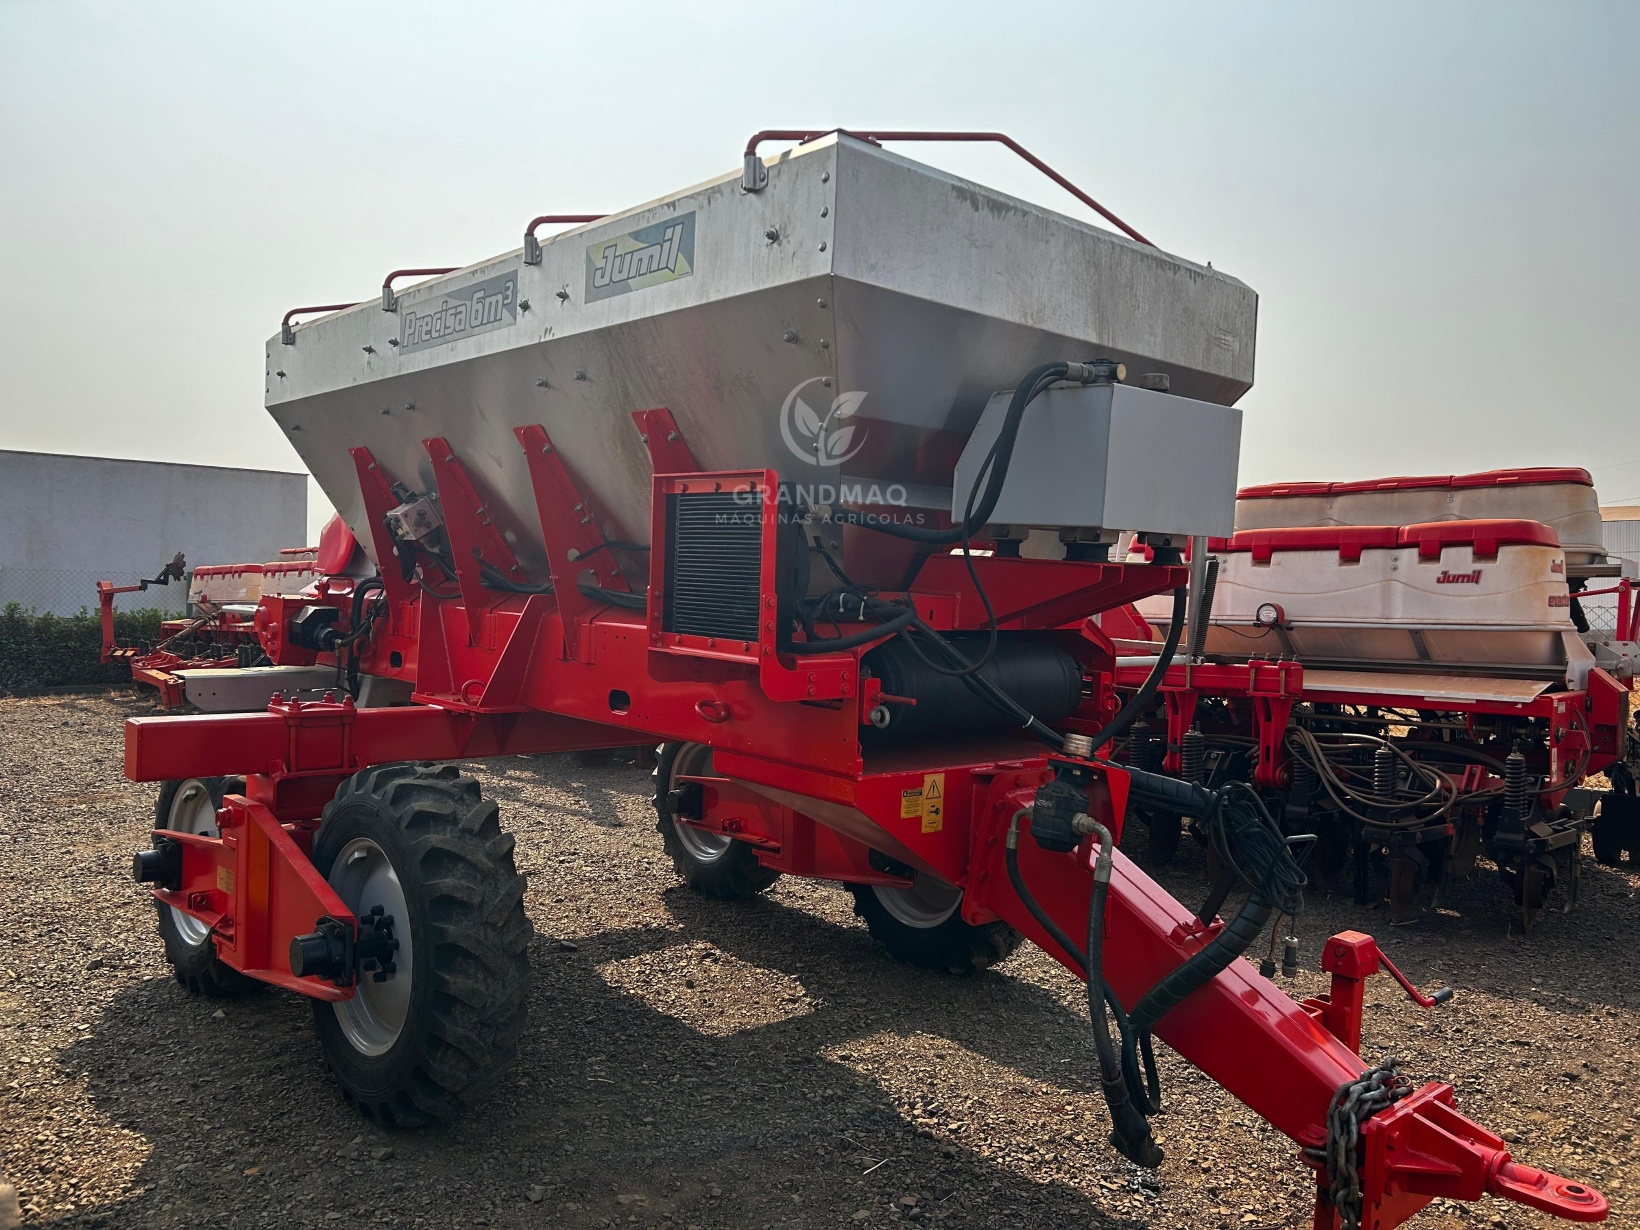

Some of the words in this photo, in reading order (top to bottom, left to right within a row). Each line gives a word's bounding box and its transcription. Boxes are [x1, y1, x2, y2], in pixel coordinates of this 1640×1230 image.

[593, 222, 684, 288] Jumil
[402, 301, 467, 348] Precisa
[1436, 569, 1482, 585] Jumil
